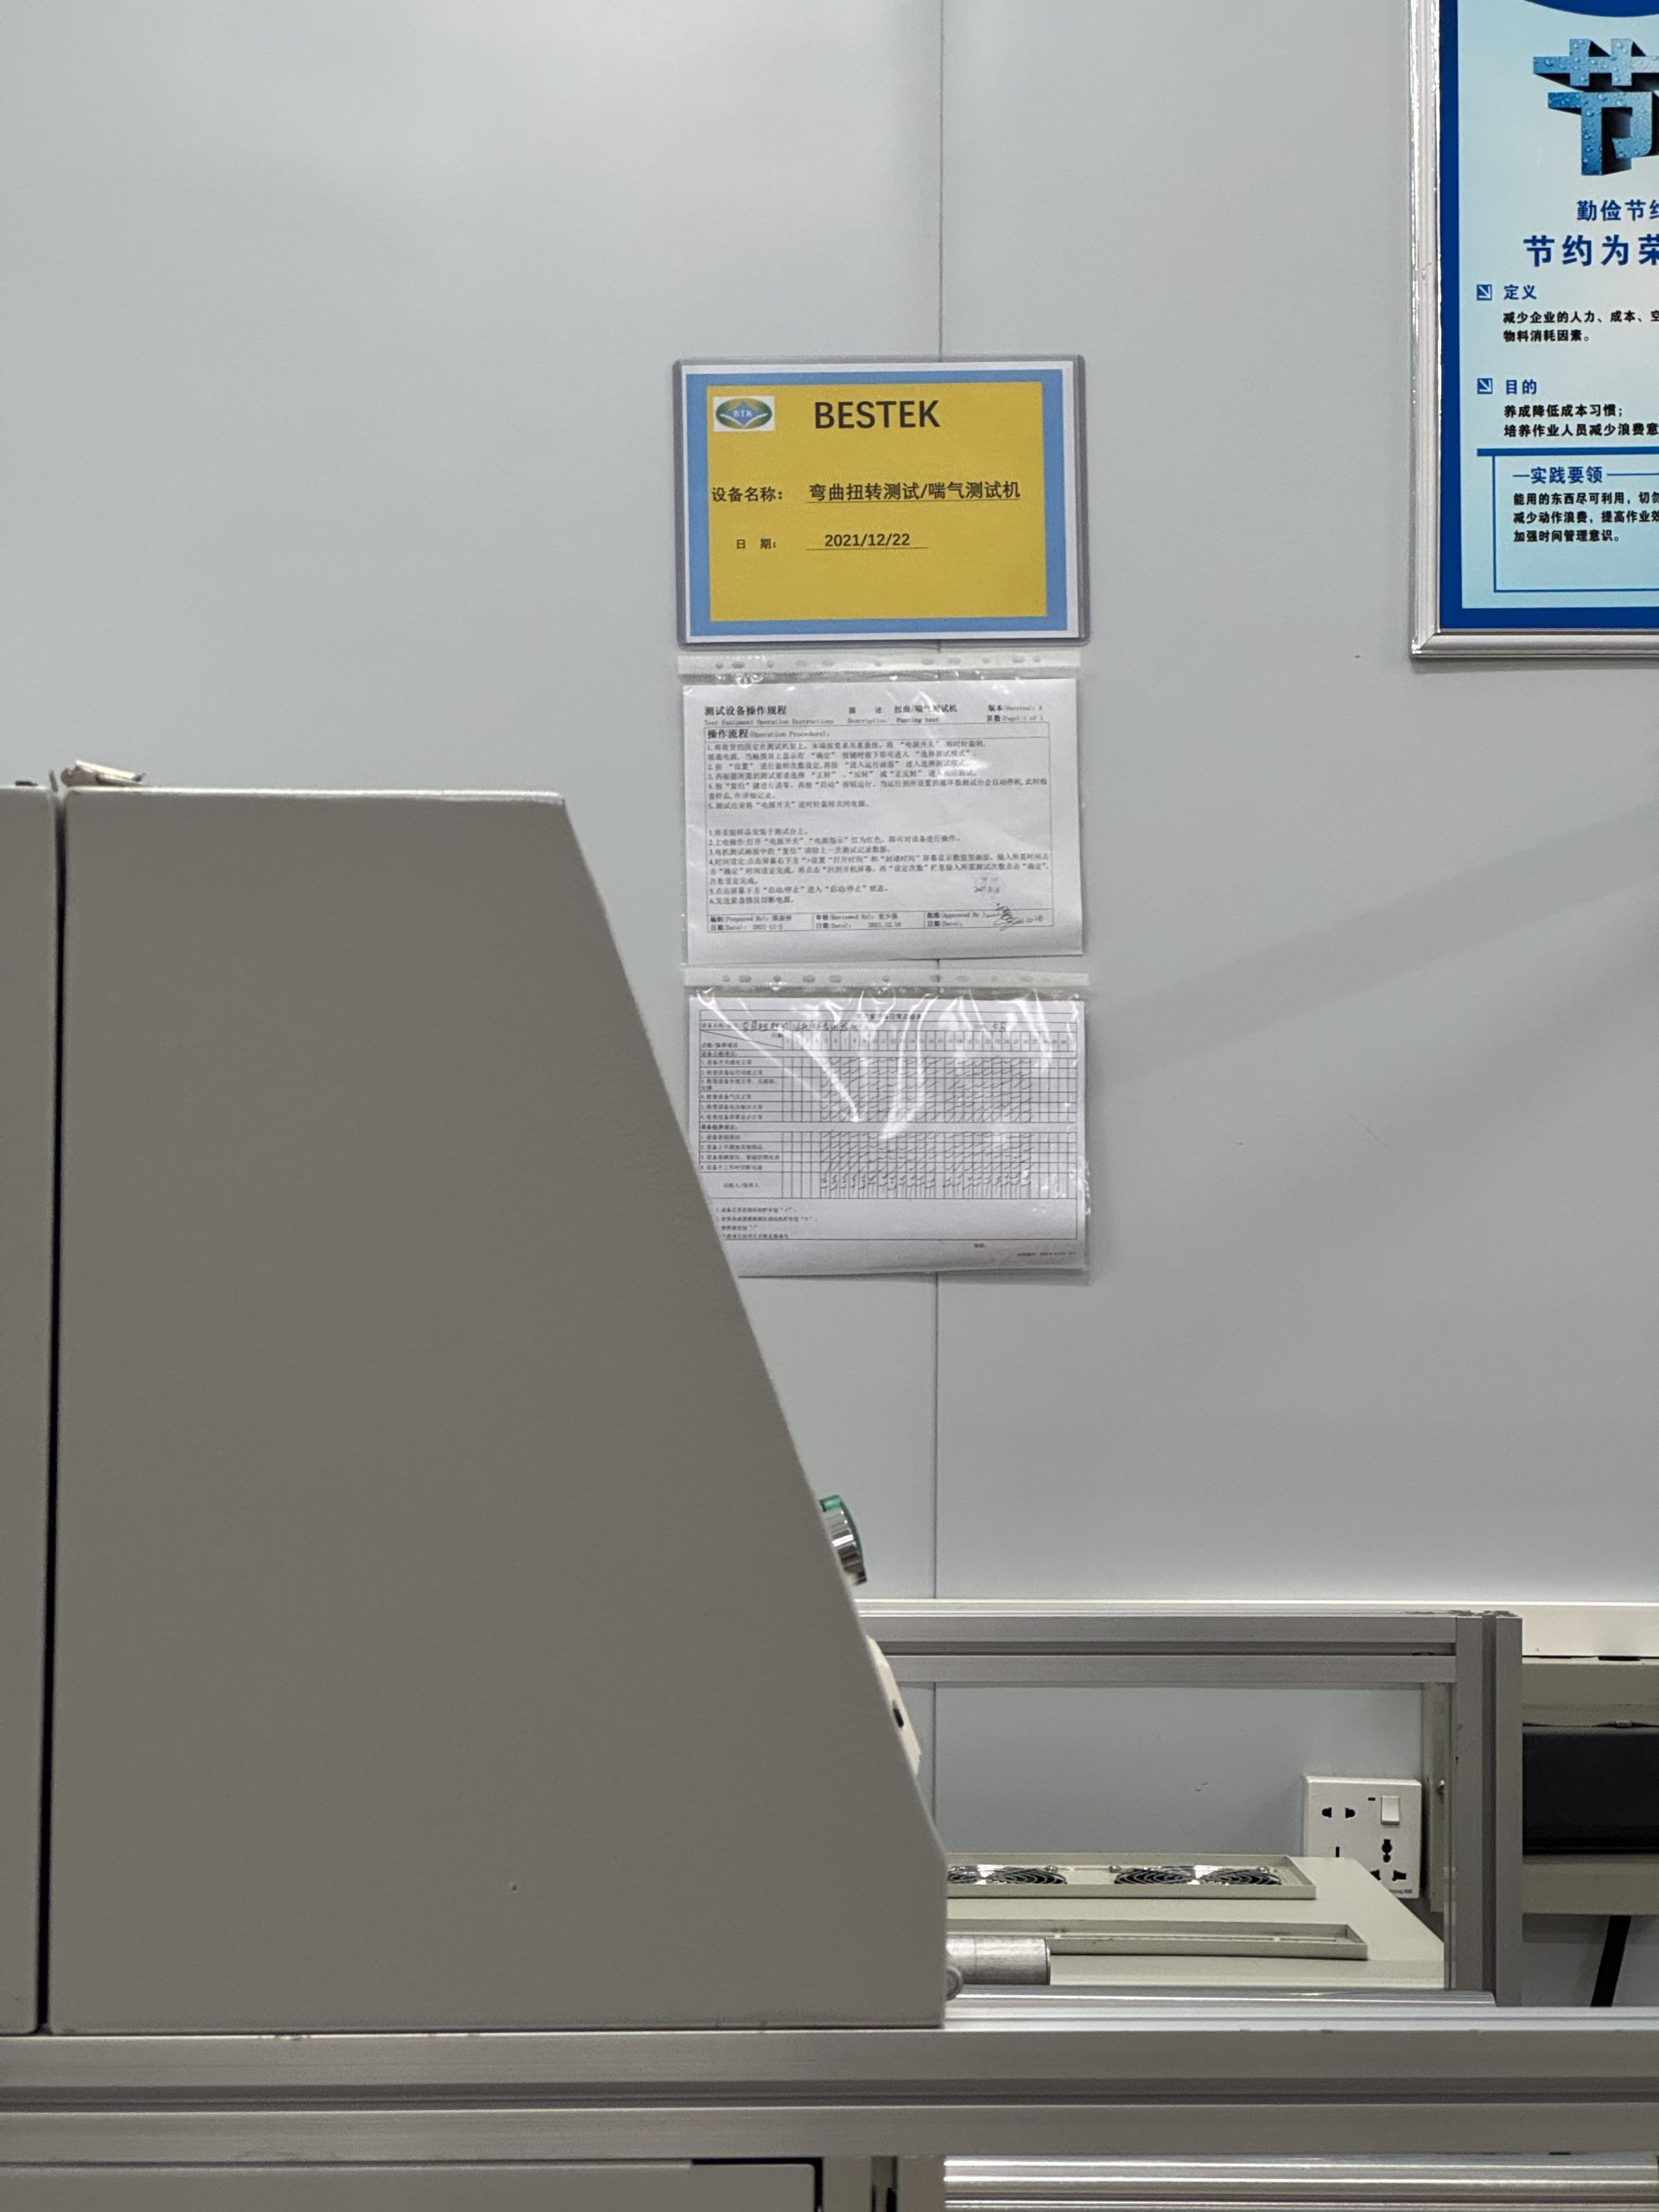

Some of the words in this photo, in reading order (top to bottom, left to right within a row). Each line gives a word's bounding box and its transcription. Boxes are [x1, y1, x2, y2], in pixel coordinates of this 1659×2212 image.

[1533, 38, 1659, 176] 节
[1523, 234, 1659, 267] 节约为荣
[1503, 284, 1537, 300] 定义
[1505, 379, 1537, 395] 目的
[814, 400, 941, 429] BESTEK
[1530, 466, 1604, 484] 实践要领
[809, 480, 1020, 501] 弯曲扭转测试/喘气测试机
[824, 533, 911, 548] 2021/12/22
[704, 705, 787, 716] 测试设备操作规程
